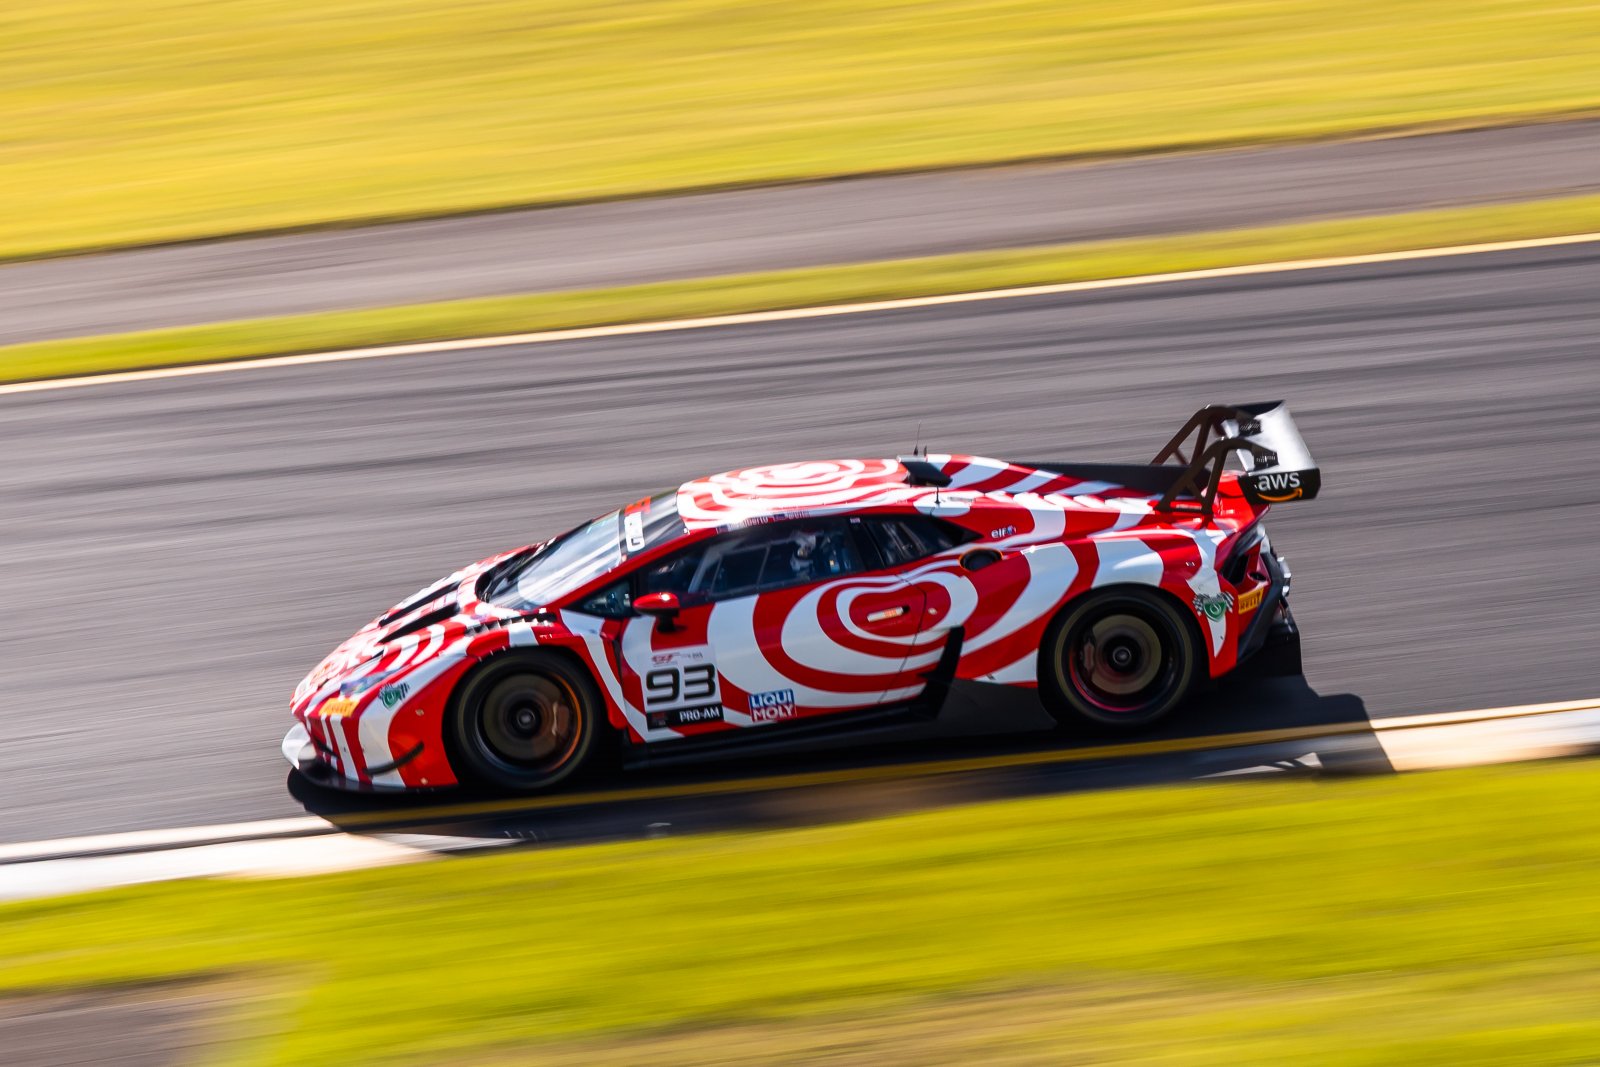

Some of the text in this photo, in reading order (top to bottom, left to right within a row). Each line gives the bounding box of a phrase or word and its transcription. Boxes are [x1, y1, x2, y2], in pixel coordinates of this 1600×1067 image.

[1258, 472, 1300, 491] aws
[646, 663, 716, 705] 93
[751, 691, 793, 708] LIQUI
[679, 706, 721, 722] PRO-AM
[752, 704, 794, 721] MOLY
